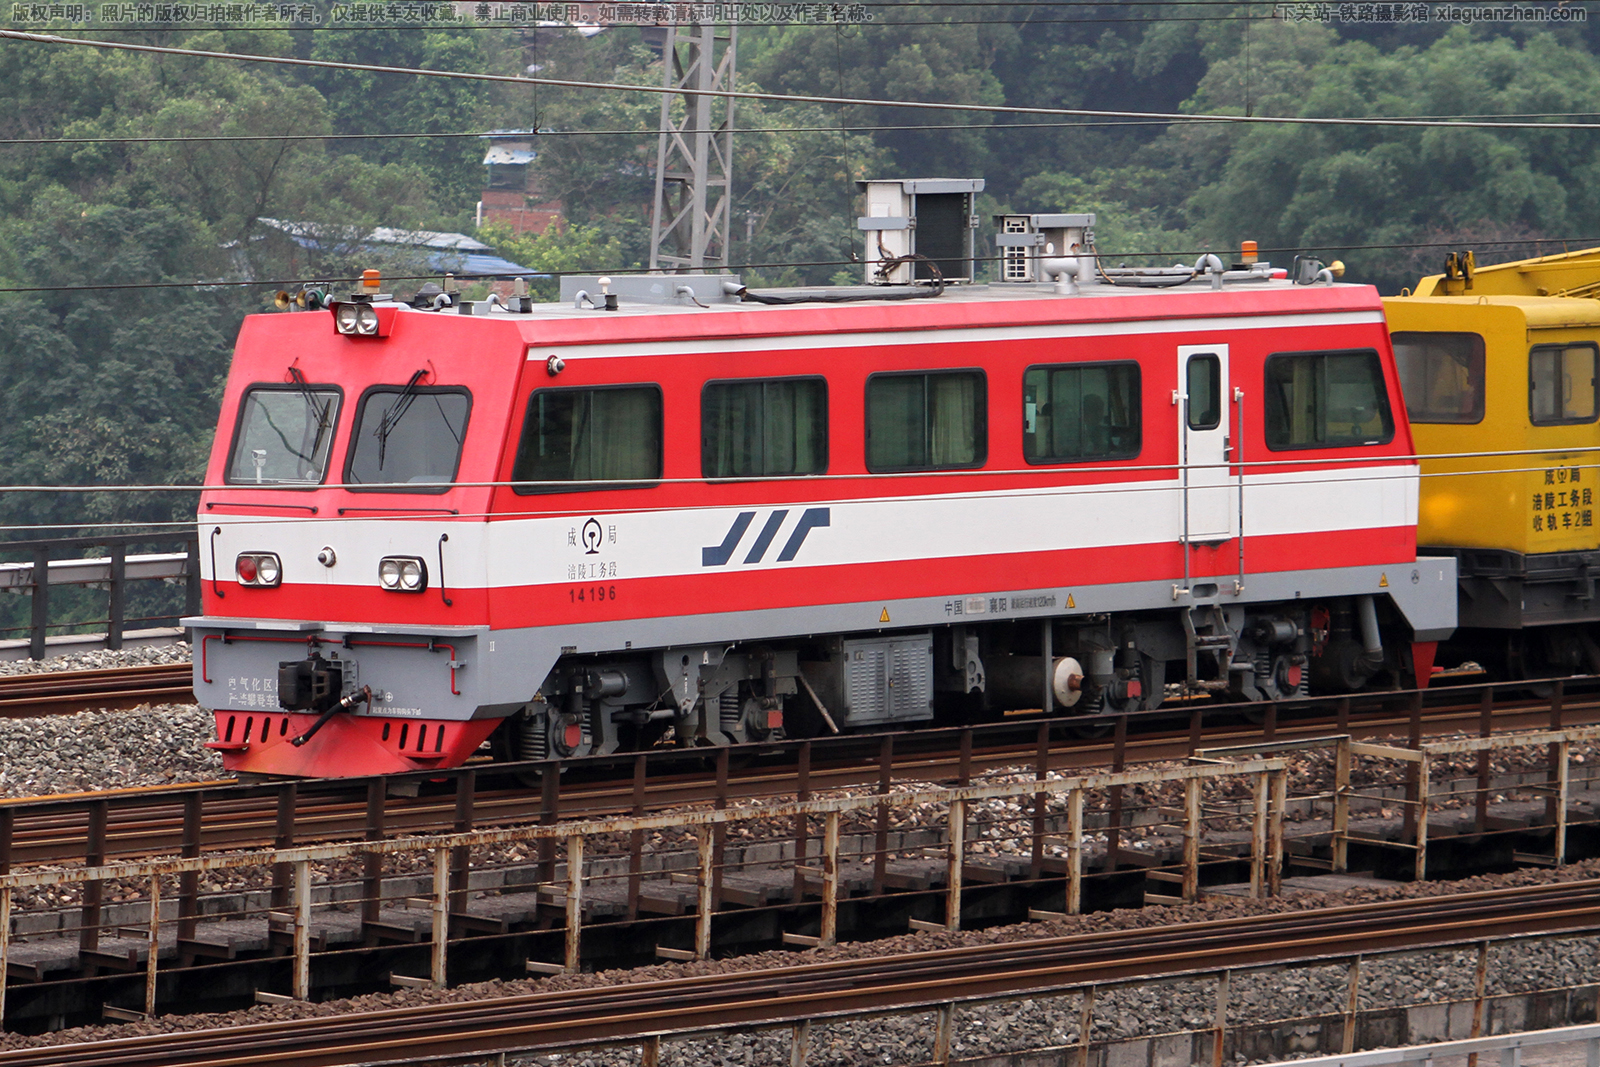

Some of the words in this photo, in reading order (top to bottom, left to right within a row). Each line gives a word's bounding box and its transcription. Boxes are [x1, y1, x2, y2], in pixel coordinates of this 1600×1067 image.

[1533, 488, 1592, 511] 涪陵工务段
[568, 527, 577, 546] 成
[608, 525, 617, 544] 局
[568, 561, 617, 580] 涪陵工务段
[569, 586, 616, 603] 14196
[945, 600, 963, 616] 中国
[989, 597, 1007, 613] 襄阳
[228, 676, 279, 693] 电气化区
